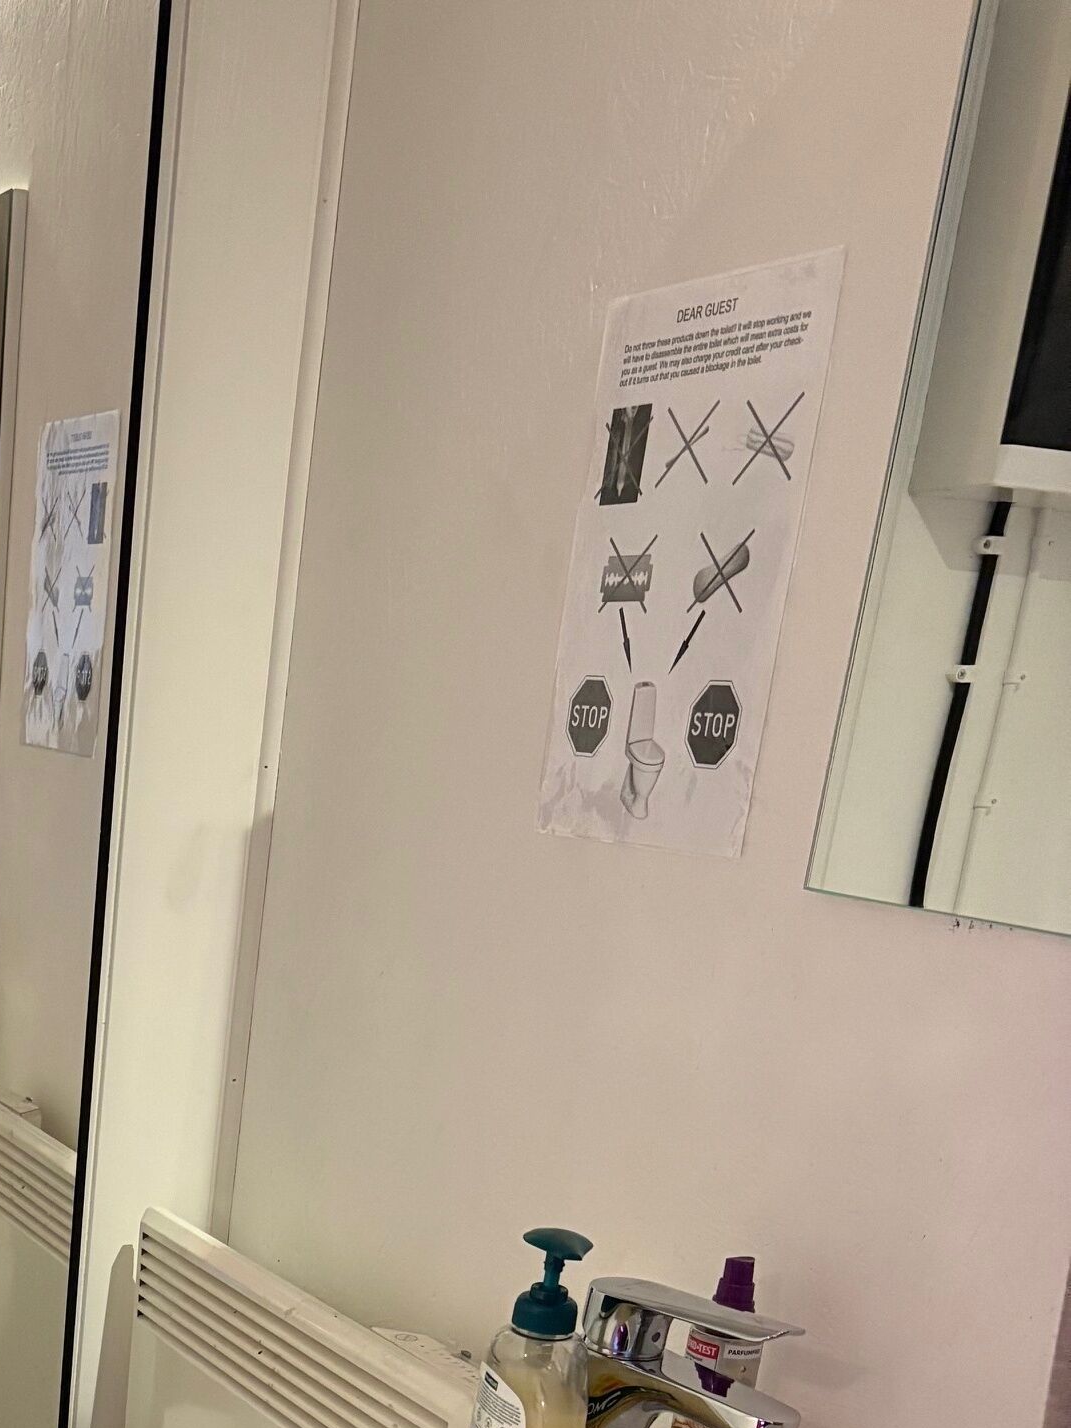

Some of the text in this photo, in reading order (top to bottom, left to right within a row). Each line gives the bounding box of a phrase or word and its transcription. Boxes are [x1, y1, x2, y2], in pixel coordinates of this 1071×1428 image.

[677, 297, 739, 323] DEAR GUEST
[625, 345, 632, 353] Do
[633, 344, 641, 352] not
[642, 341, 656, 350] throw
[657, 338, 671, 347] these
[672, 333, 694, 346] products
[695, 330, 709, 340] down
[711, 327, 719, 337] the
[742, 320, 752, 330] will
[753, 319, 766, 329] stop
[766, 315, 789, 325] working
[790, 312, 802, 321] and
[802, 310, 812, 319] we
[632, 353, 644, 363] have
[645, 352, 650, 361] to
[683, 344, 692, 353] the
[693, 342, 708, 352] entire
[709, 338, 722, 348] toilet
[723, 335, 738, 345] which
[740, 332, 749, 342] will
[750, 332, 766, 341] mean
[783, 325, 798, 335] costs
[800, 321, 809, 332] for
[619, 379, 628, 388] out
[637, 376, 649, 385] turns
[650, 372, 659, 382] out
[659, 371, 669, 381] that
[670, 370, 679, 380] you
[681, 366, 700, 377] caused
[705, 361, 730, 373] blockage
[730, 358, 736, 369] in
[737, 358, 746, 368] the
[621, 368, 630, 378] you
[659, 360, 668, 370] We
[669, 359, 680, 369] may
[681, 357, 692, 366] also
[693, 352, 711, 364] charge
[712, 350, 725, 362] your
[725, 347, 741, 357] credit
[742, 344, 755, 354] card
[756, 342, 769, 352] after
[770, 340, 783, 352] your
[571, 704, 608, 729] STOP
[691, 711, 735, 738] STOP
